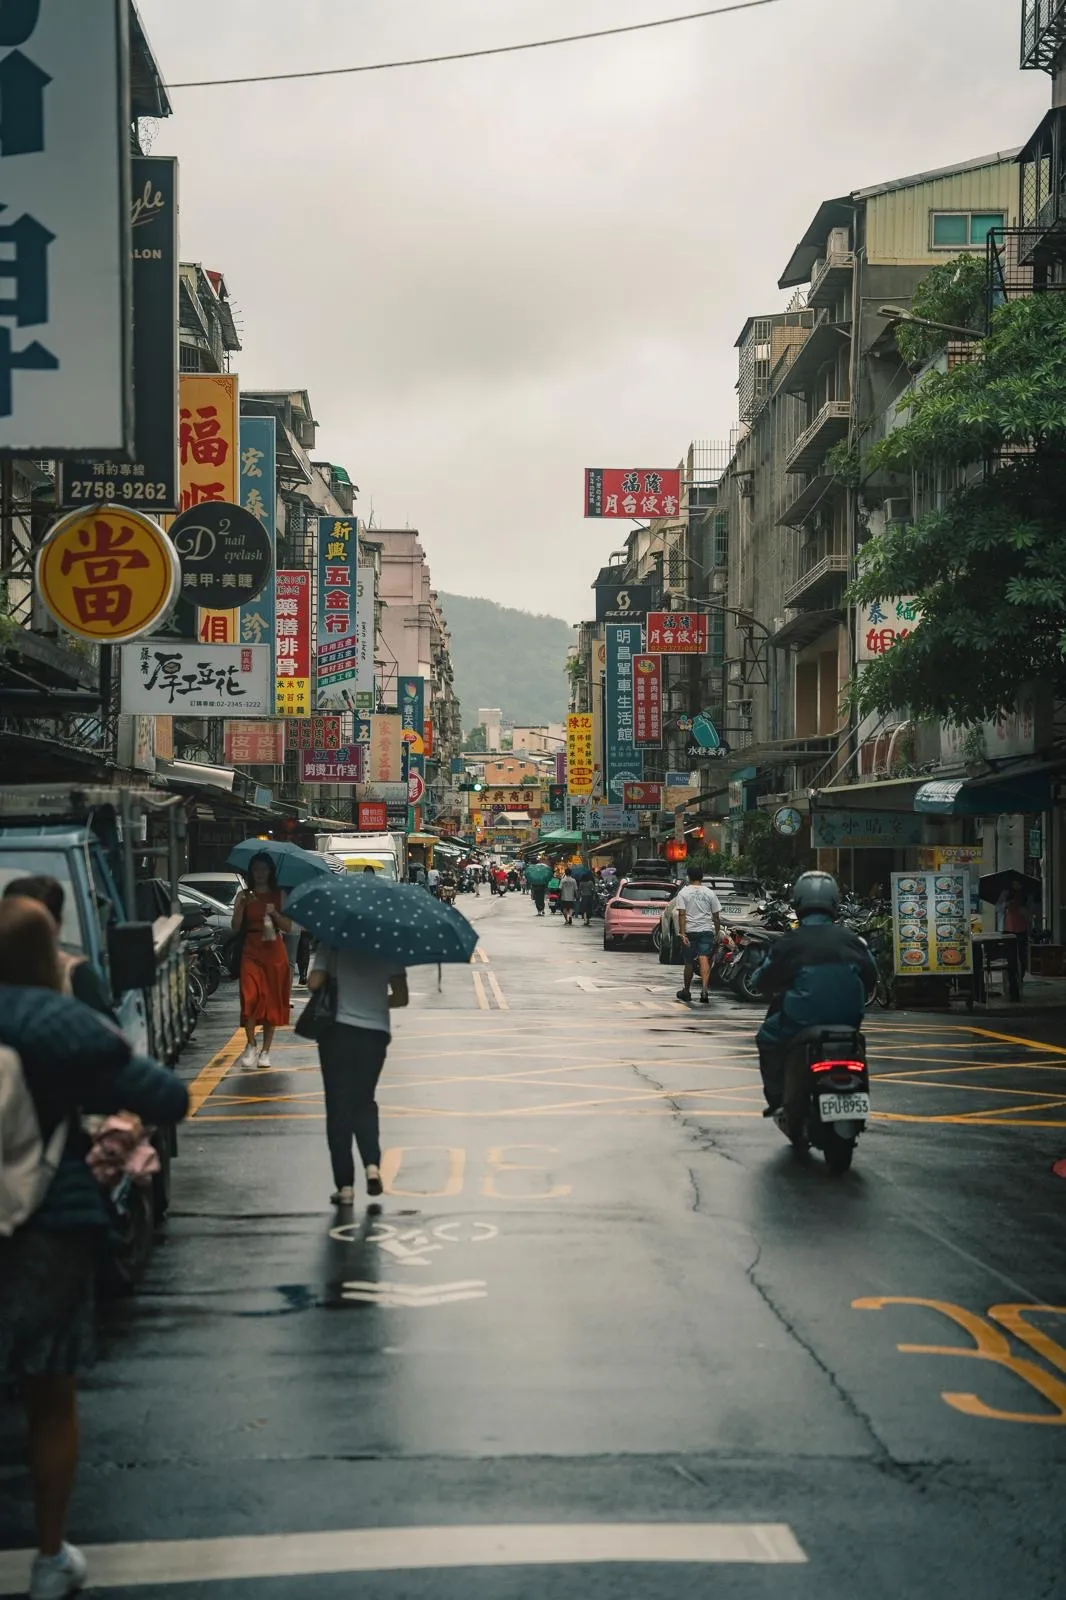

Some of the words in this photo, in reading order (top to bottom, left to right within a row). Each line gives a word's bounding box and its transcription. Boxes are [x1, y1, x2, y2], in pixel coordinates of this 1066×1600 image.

[92, 463, 145, 476] 預約專線
[71, 481, 167, 500] 2758-9262
[621, 472, 663, 494] 福隆
[604, 494, 679, 515] 月台便當
[225, 534, 246, 546] nail
[224, 549, 263, 564] eyelash
[61, 521, 151, 628] 當
[650, 629, 703, 646] 月台便當
[616, 629, 633, 742] 明昌單車生活館
[568, 717, 592, 729] 陳記
[304, 763, 358, 777] 剪燙工作室
[821, 1100, 869, 1115] EPU-8953
